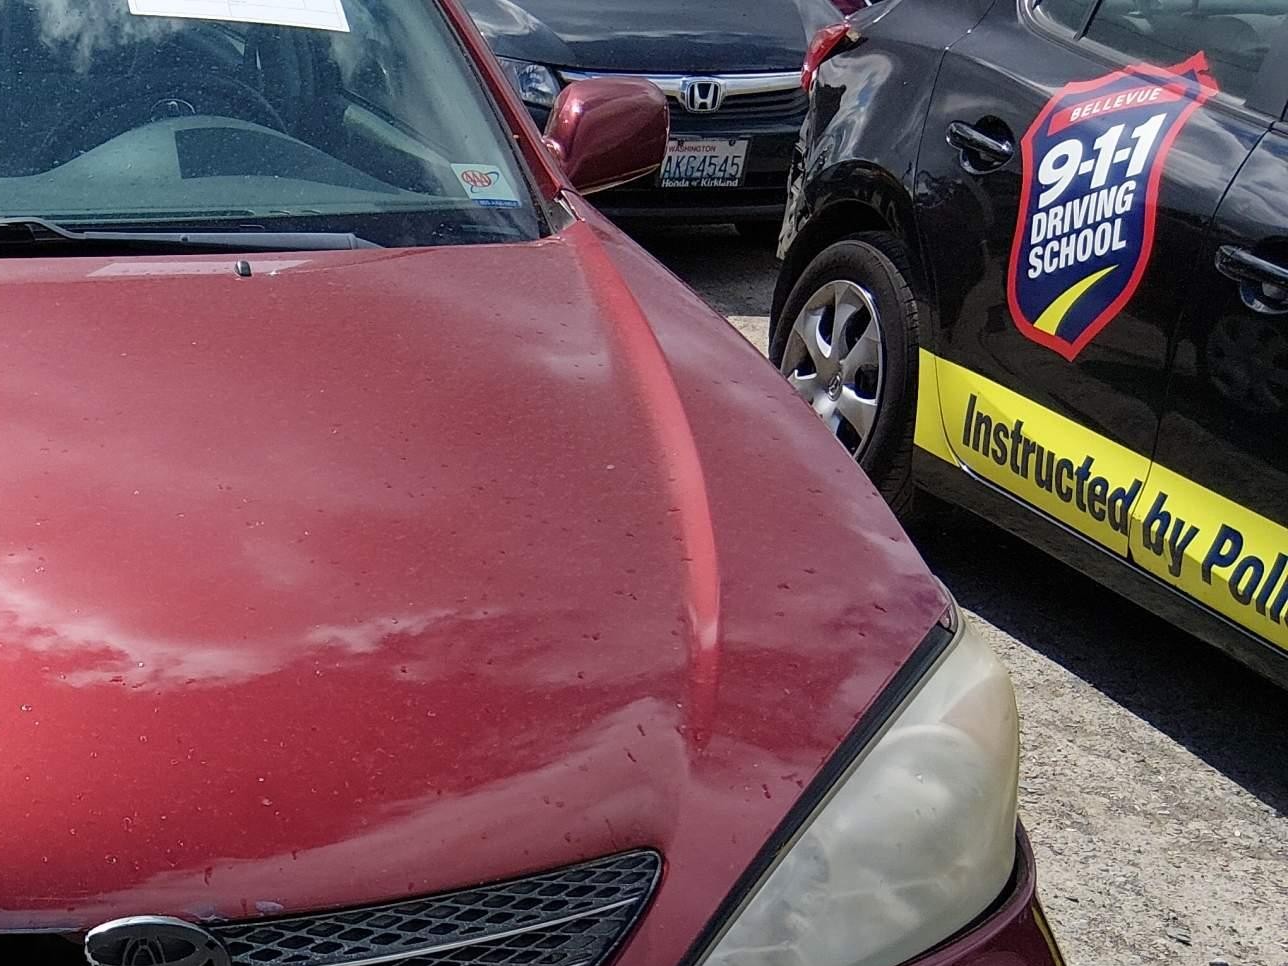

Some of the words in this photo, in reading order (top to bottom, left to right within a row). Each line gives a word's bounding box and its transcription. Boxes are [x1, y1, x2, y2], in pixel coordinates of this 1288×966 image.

[1070, 88, 1162, 121] BELLEVUE
[669, 145, 716, 153] WASHINGTON
[1038, 113, 1167, 209] 9-1-1
[462, 171, 491, 187] AAA
[661, 179, 689, 187] Honda
[700, 178, 739, 187] Kirkland
[663, 155, 742, 179] AKG4545
[1031, 180, 1137, 245] DRIVING
[1028, 218, 1127, 279] SCHOOL
[962, 393, 1143, 537] Instructed
[1142, 491, 1199, 578] by
[1201, 523, 1288, 627] Poli
